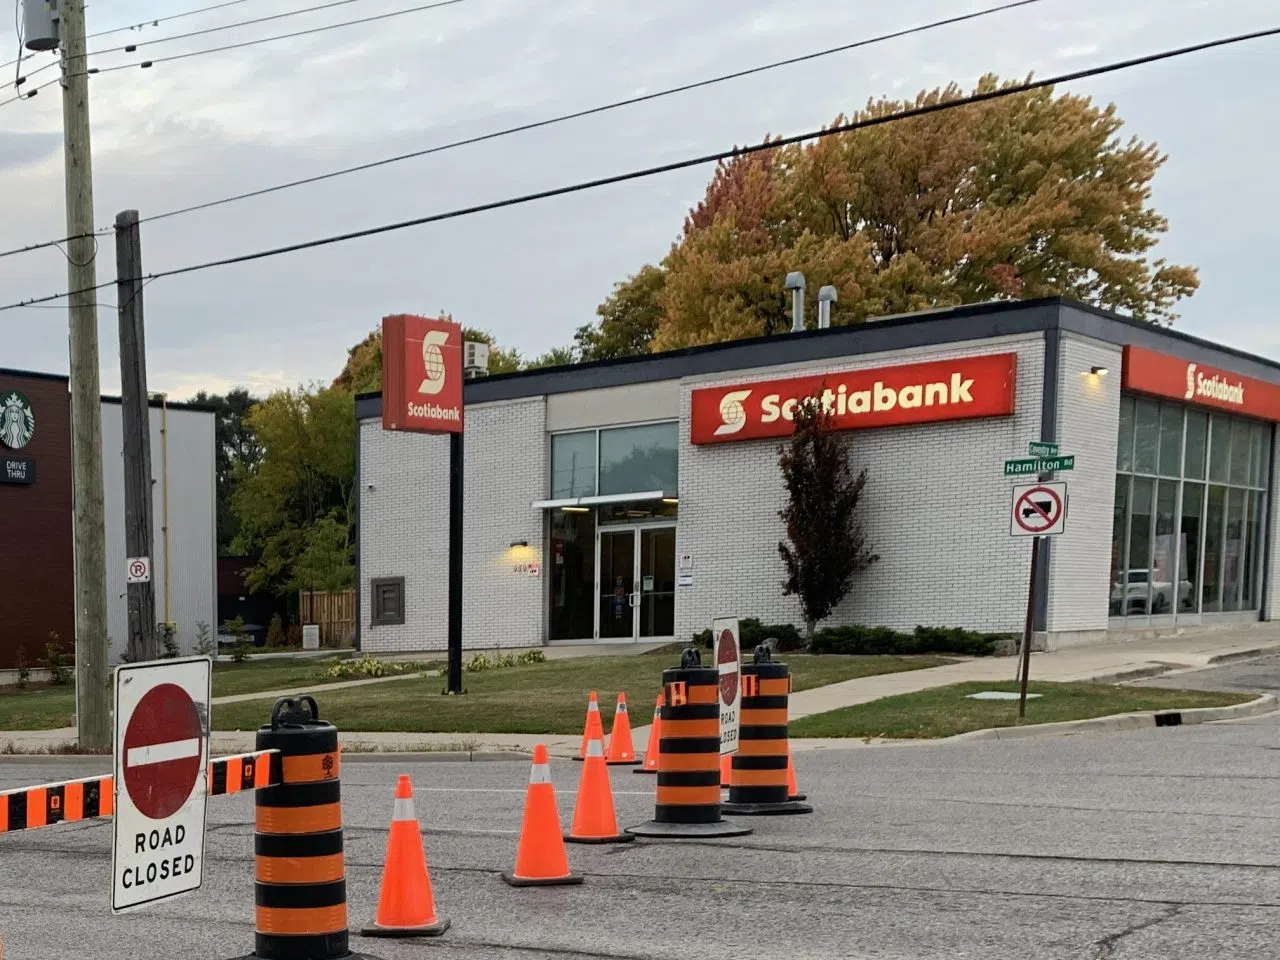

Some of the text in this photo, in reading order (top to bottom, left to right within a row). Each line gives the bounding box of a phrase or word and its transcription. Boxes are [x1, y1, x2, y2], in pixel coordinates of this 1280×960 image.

[1196, 371, 1245, 405] Scotiabank
[407, 402, 461, 421] Scotiabank
[6, 461, 27, 470] DRIVE
[1006, 460, 1060, 473] Hamilton
[7, 470, 26, 479] THRU
[721, 710, 736, 725] ROAD
[720, 728, 737, 745] LOSED
[135, 824, 186, 854] ROAD
[122, 853, 195, 890] CLOSED
